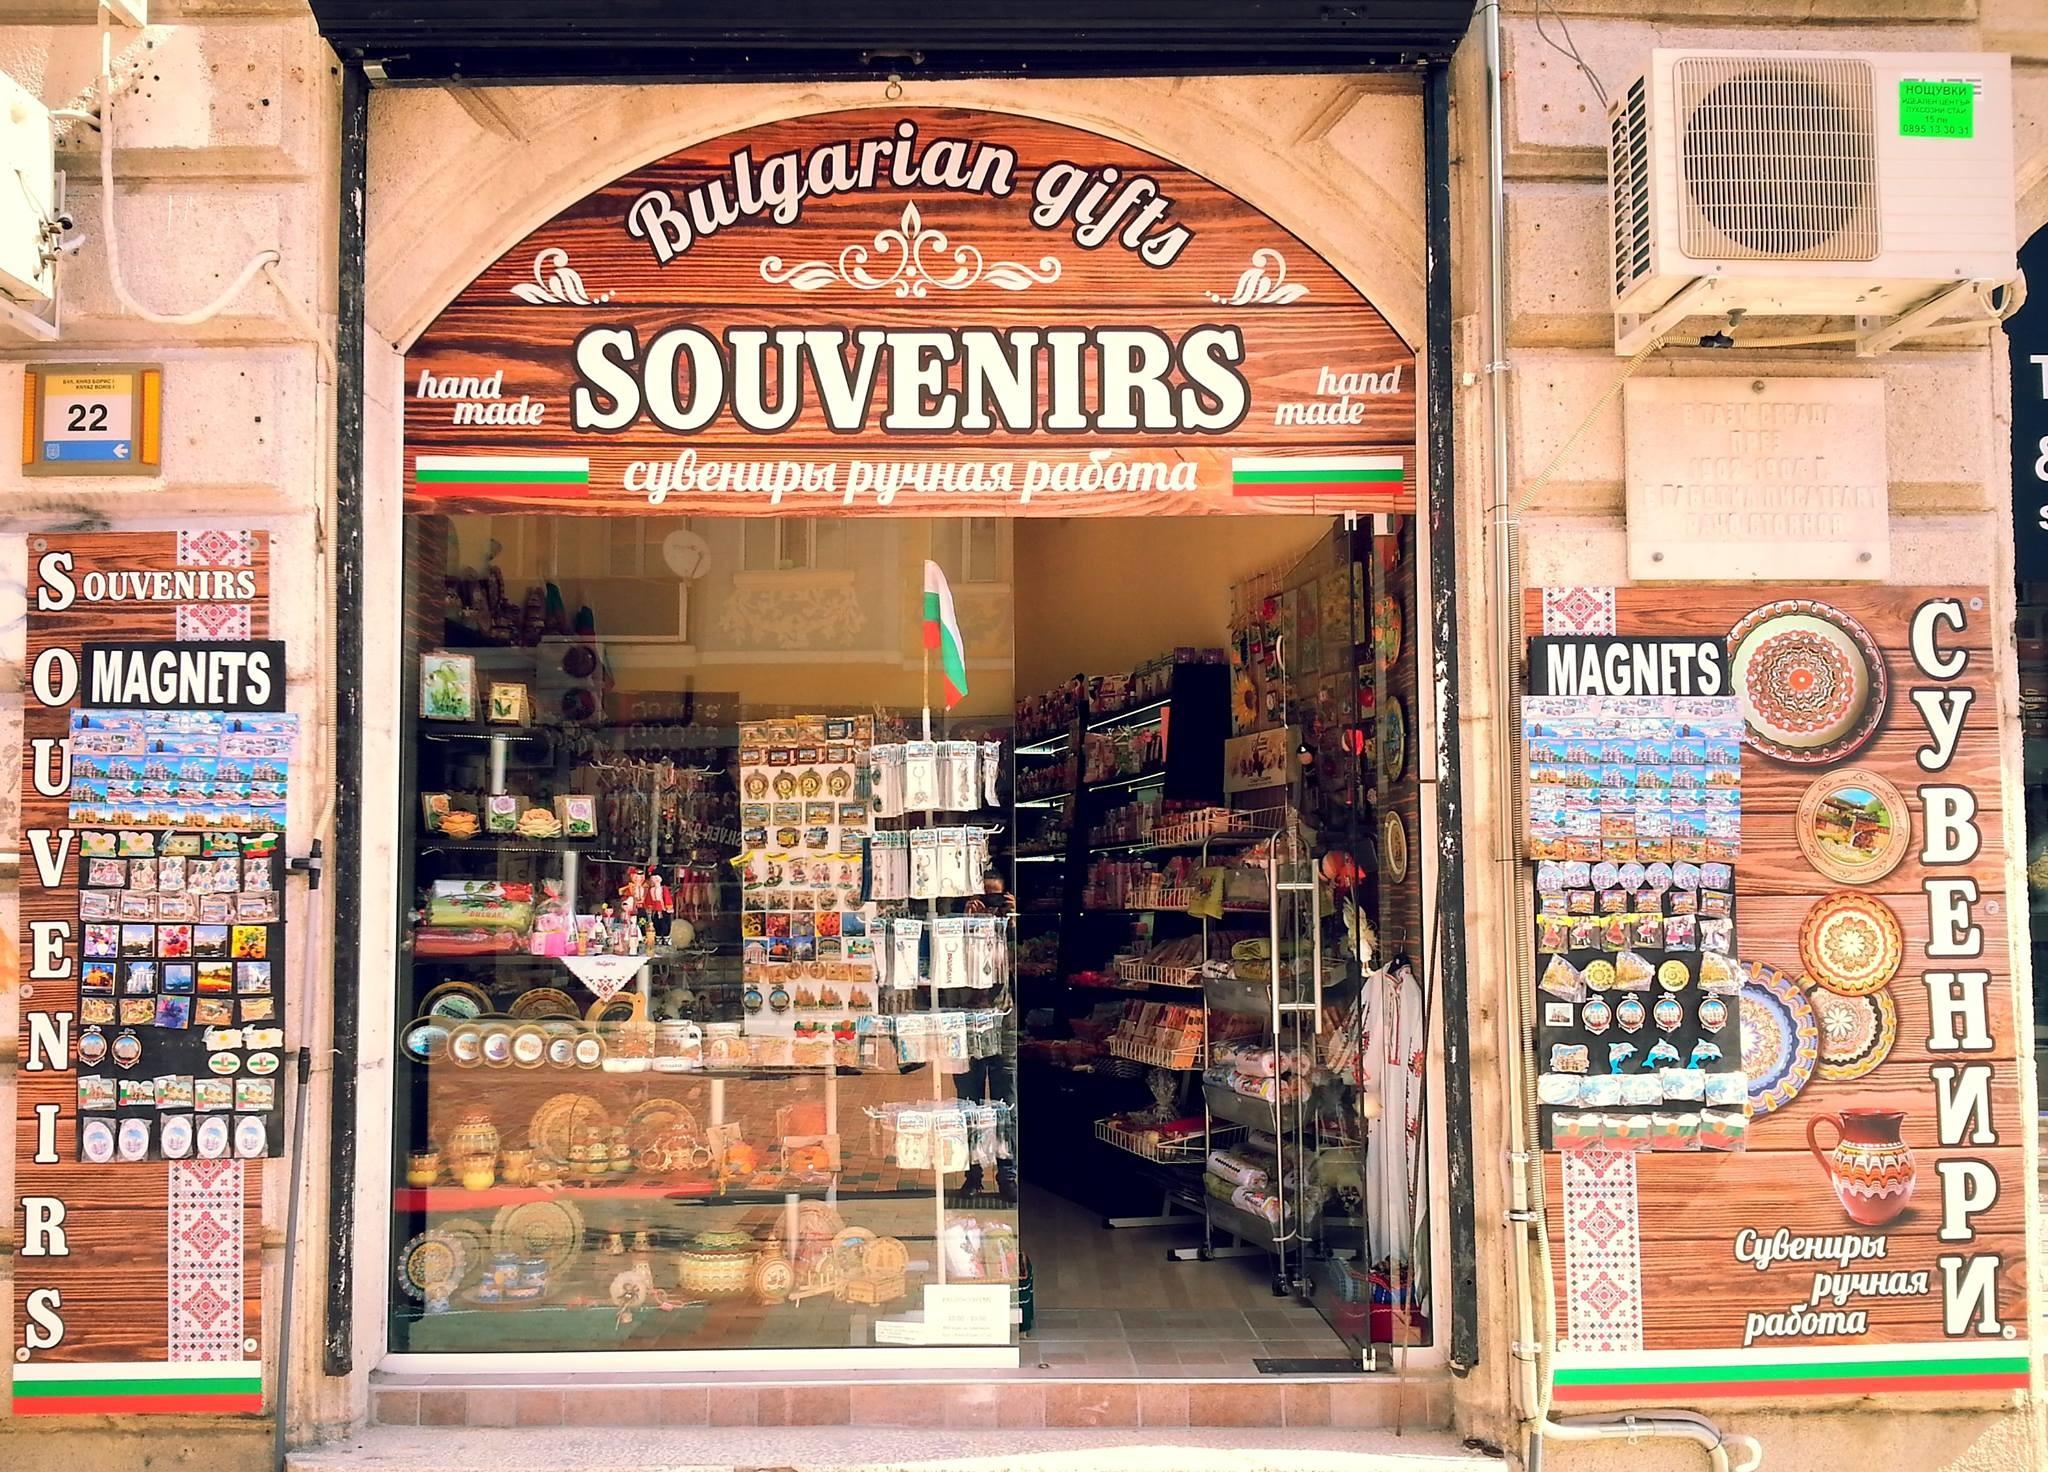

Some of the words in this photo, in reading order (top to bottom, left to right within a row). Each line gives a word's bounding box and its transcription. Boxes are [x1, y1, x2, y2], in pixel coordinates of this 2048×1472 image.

[1906, 85, 1967, 96] НОЩУВКИ
[1903, 124, 1926, 133] 0895
[1943, 125, 1955, 134] 30
[1958, 126, 1969, 134] 31
[625, 119, 1017, 266] Bulgarian
[1032, 160, 1194, 267] gifts
[416, 370, 503, 400] hand
[573, 326, 1248, 433] SOUVENIRS
[1316, 366, 1401, 396] hand
[68, 404, 107, 431] 22
[453, 396, 546, 426] made
[1274, 396, 1365, 426] made
[623, 448, 836, 505] сувениры
[842, 459, 1014, 507] ручная
[1020, 450, 1198, 504] работа
[37, 551, 257, 611] SOUVENIRS
[92, 650, 271, 705] MAGNETS
[1546, 641, 1723, 696] MAGNETS
[1909, 598, 2001, 1339] СУВЕНИРИ
[1733, 1228, 1888, 1270] Сувениры
[1810, 1268, 1930, 1307] ручная
[1743, 1305, 1869, 1348] работа
